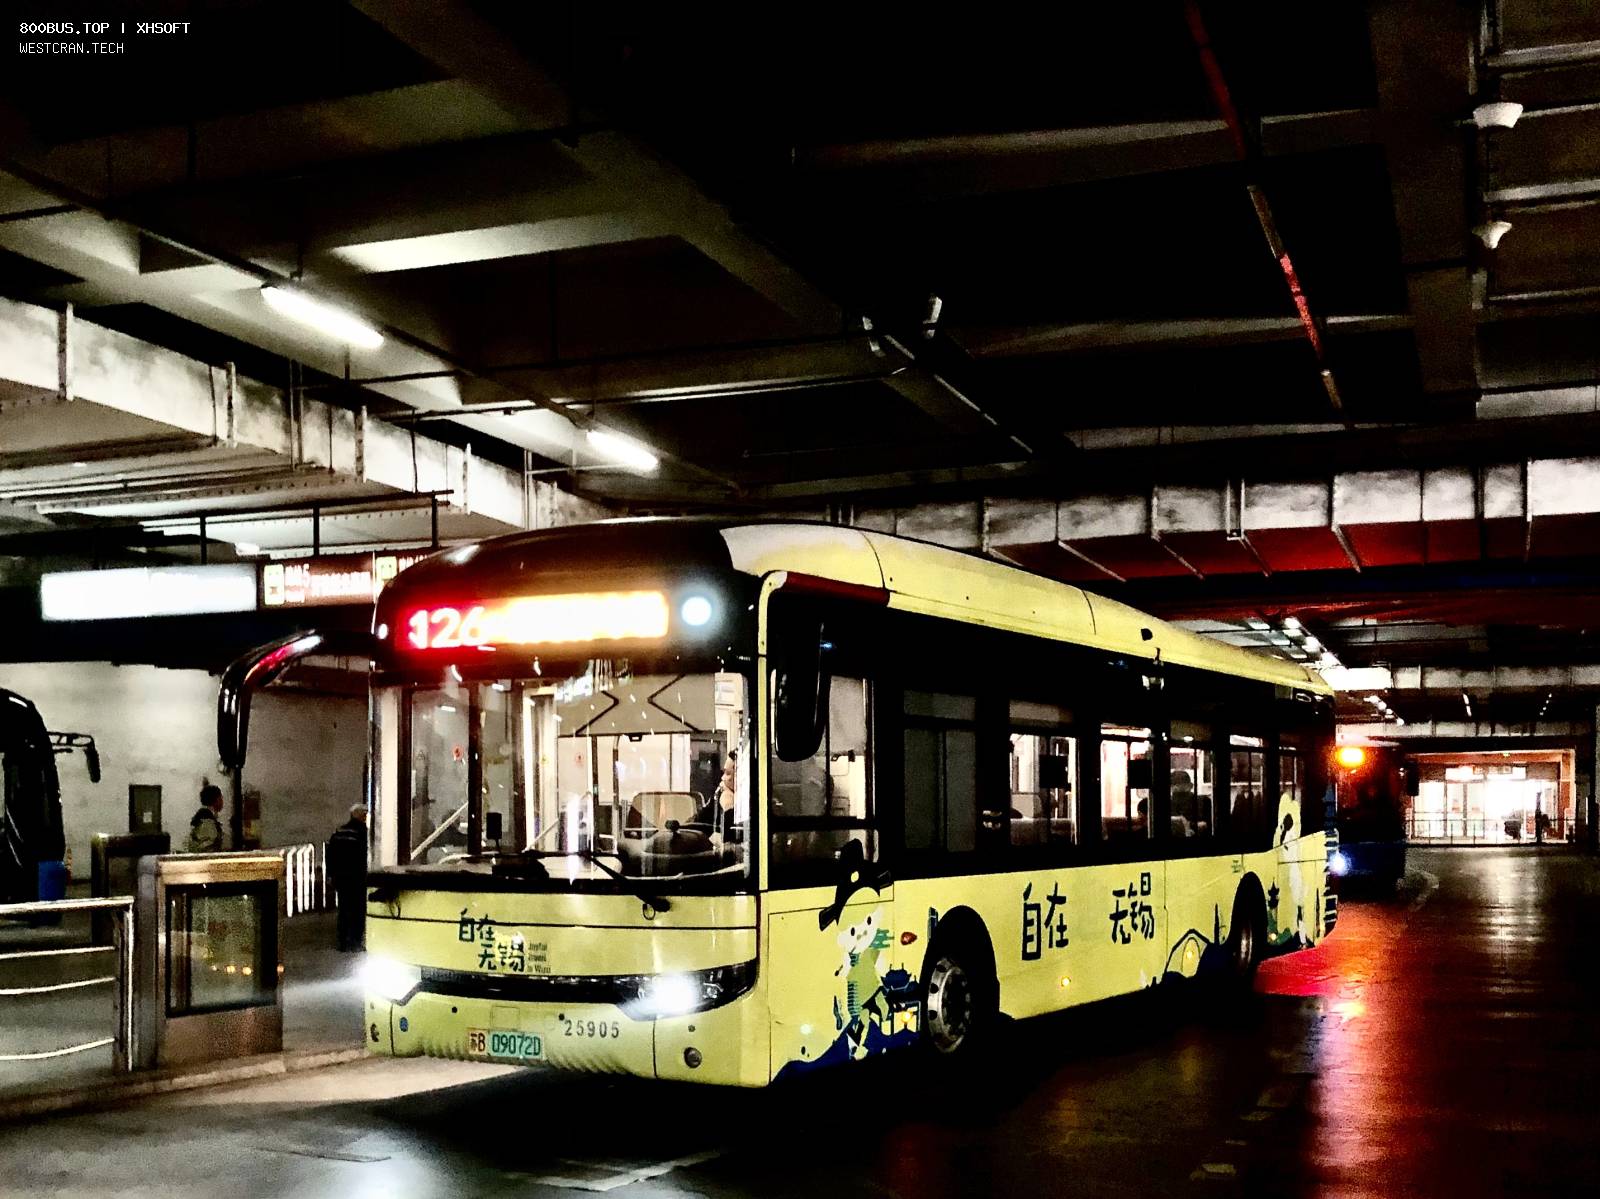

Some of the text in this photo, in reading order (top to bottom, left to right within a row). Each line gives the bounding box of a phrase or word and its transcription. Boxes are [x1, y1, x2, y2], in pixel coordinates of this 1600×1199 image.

[408, 606, 486, 649] 126
[458, 908, 497, 943] 自在
[1021, 872, 1155, 961] 自在 无锡
[478, 934, 525, 973] 无锡
[492, 1033, 541, 1056] 09072D
[564, 1019, 620, 1039] 25905
